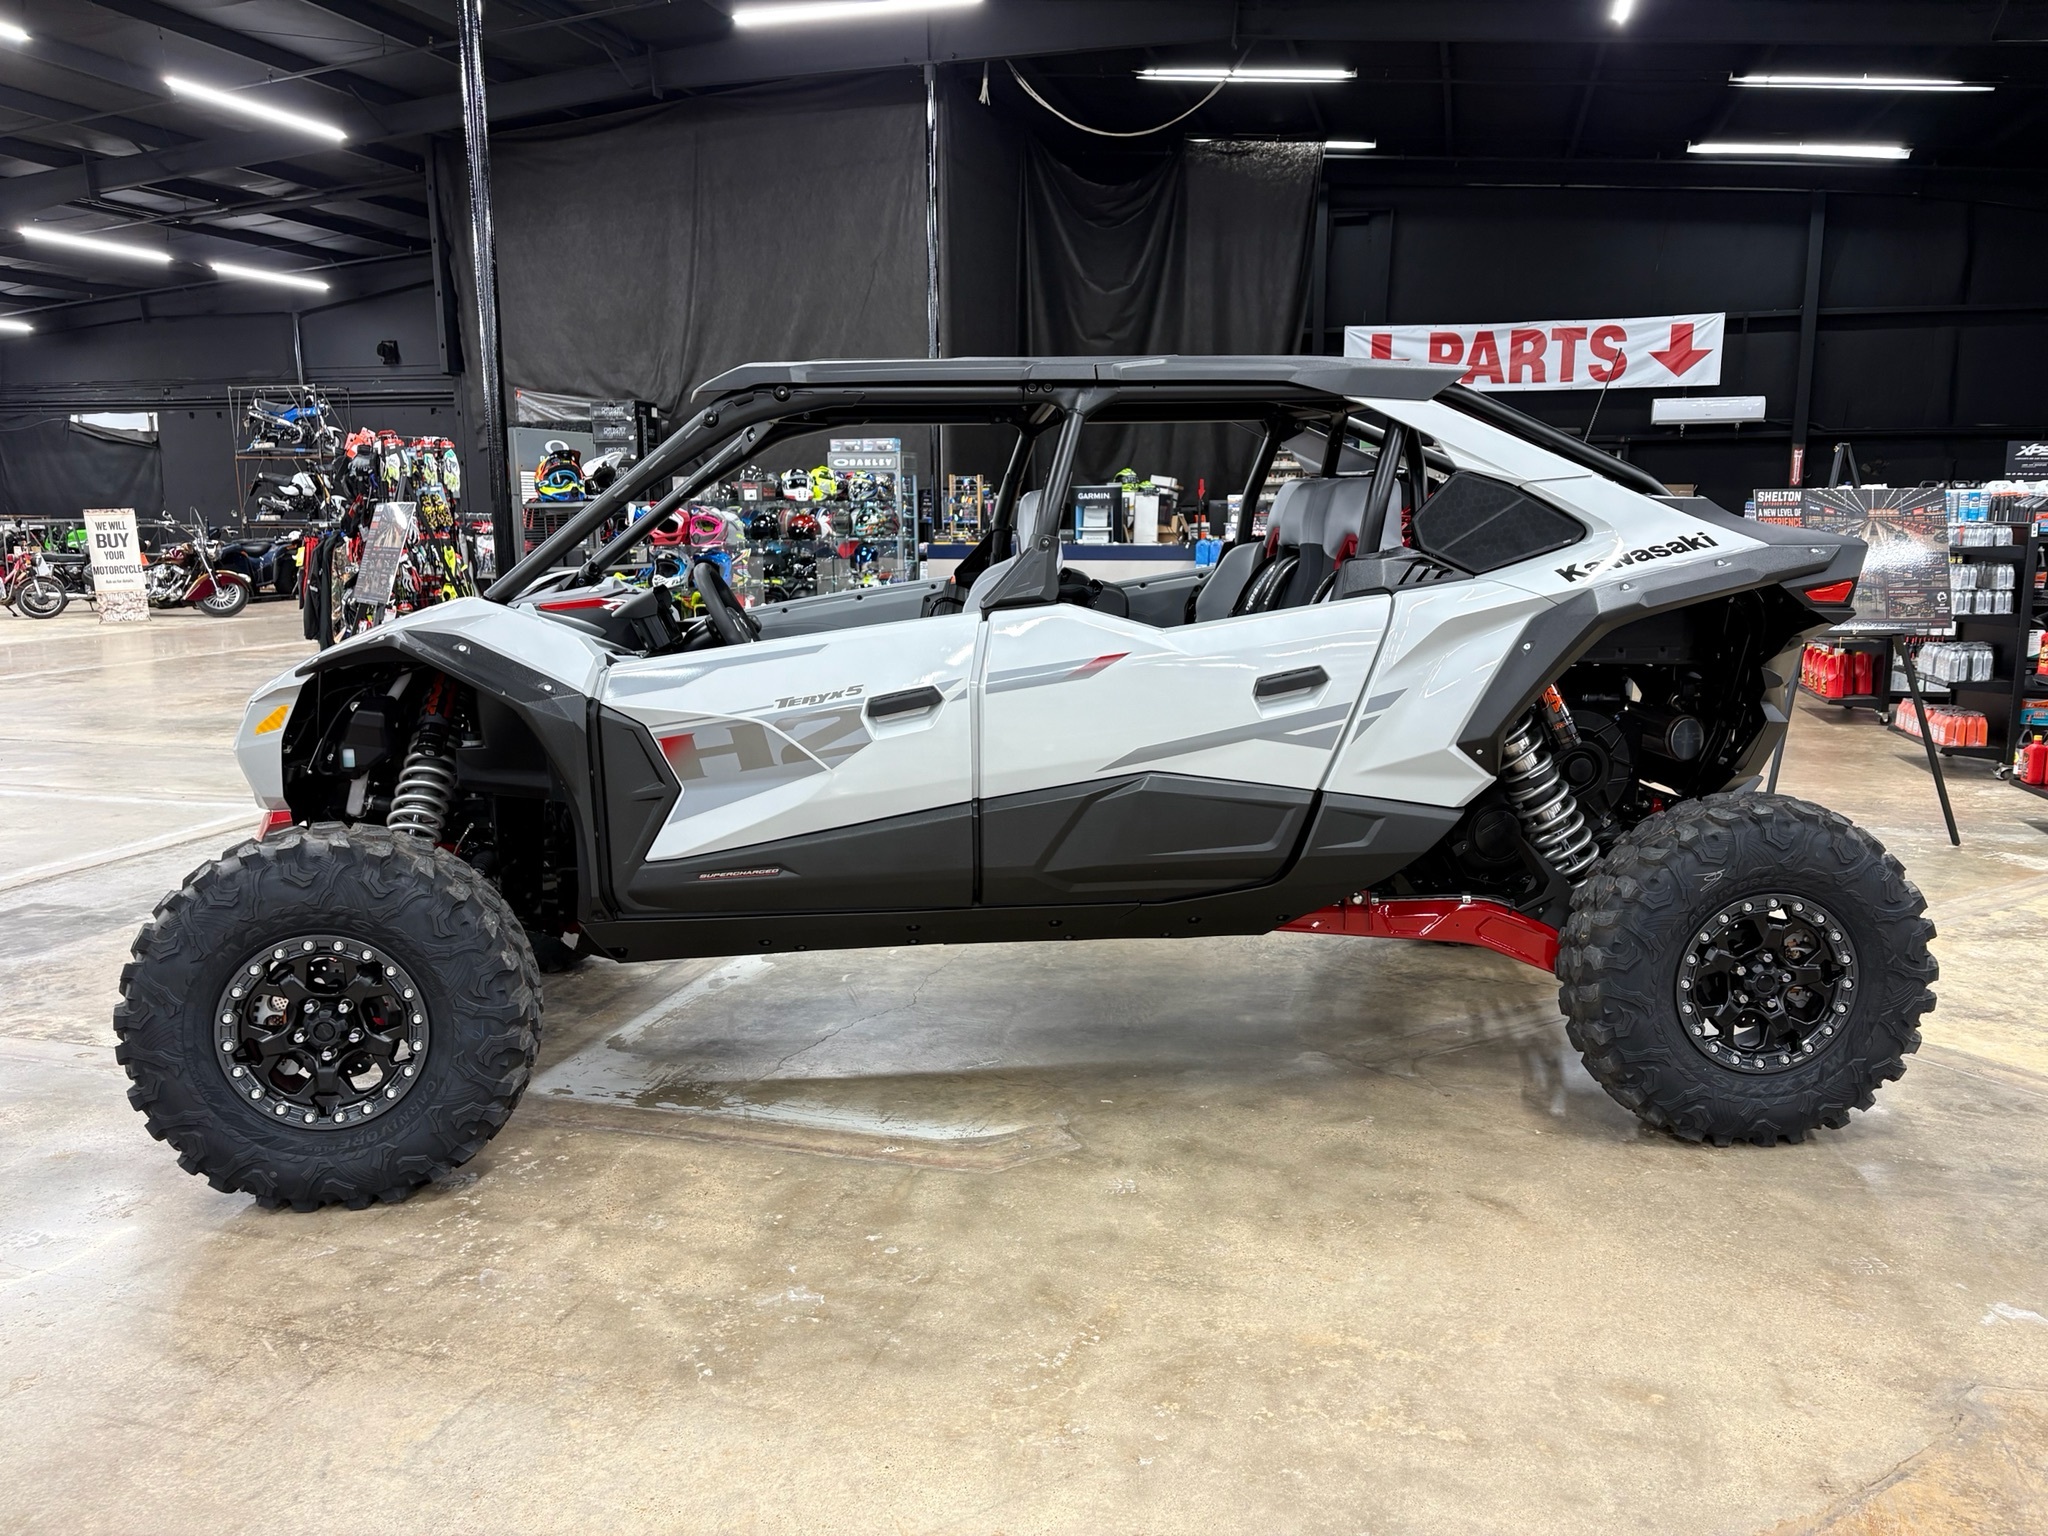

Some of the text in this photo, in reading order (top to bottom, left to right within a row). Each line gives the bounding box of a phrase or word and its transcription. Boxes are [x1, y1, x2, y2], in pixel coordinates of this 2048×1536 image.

[1428, 324, 1628, 385] PARTS
[1757, 491, 1802, 502] SHELTON
[1763, 508, 1777, 517] NEW
[1777, 508, 1794, 517] LEVEL
[1794, 508, 1802, 517] OF
[95, 521, 127, 531] WE WILL
[95, 532, 129, 549] BUY
[103, 550, 125, 560] YOUR
[1554, 531, 1720, 583] Kawasaki
[93, 564, 142, 576] MOTORCYCLE
[657, 705, 873, 781] H2
[698, 868, 780, 879] SUPERCHARGED
